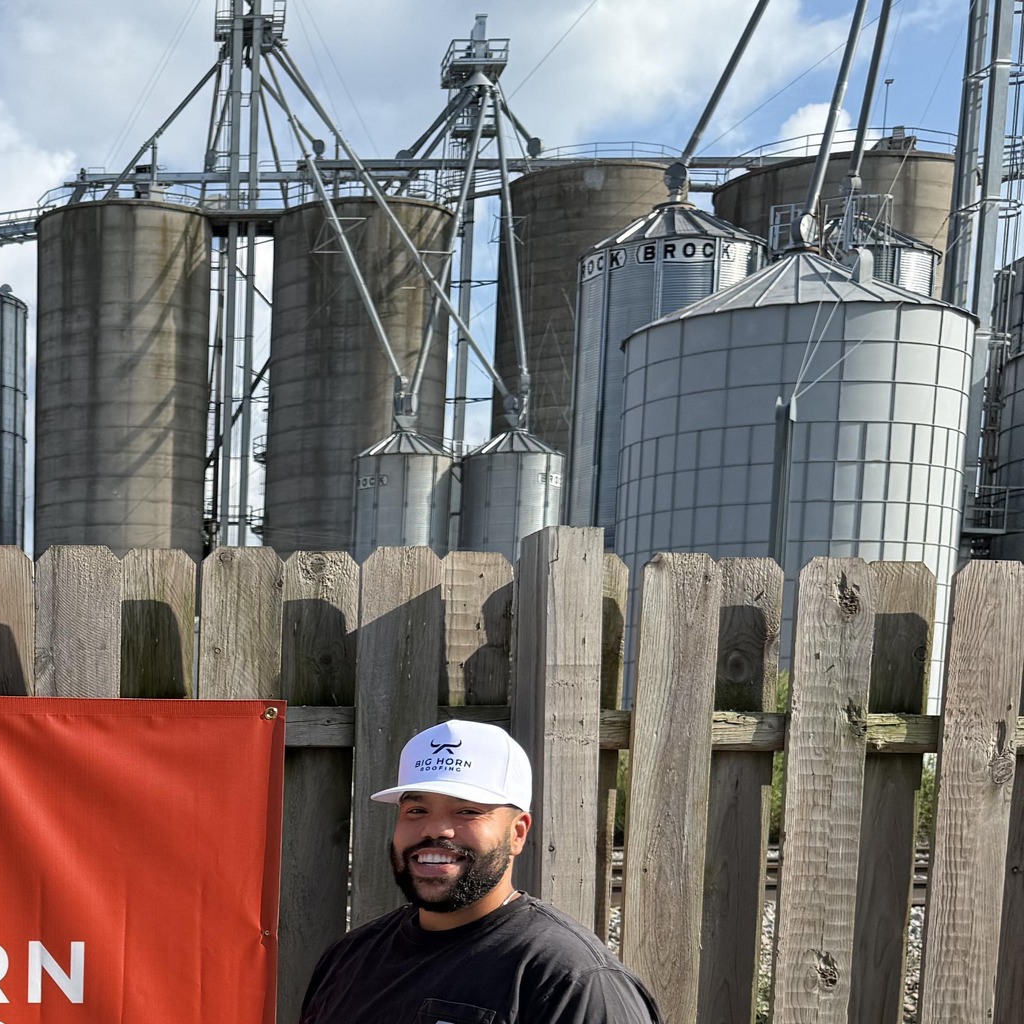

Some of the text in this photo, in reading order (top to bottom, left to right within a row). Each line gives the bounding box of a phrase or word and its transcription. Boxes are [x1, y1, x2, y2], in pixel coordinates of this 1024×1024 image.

[643, 242, 731, 261] BROCK
[415, 757, 472, 768] BIG HORN
